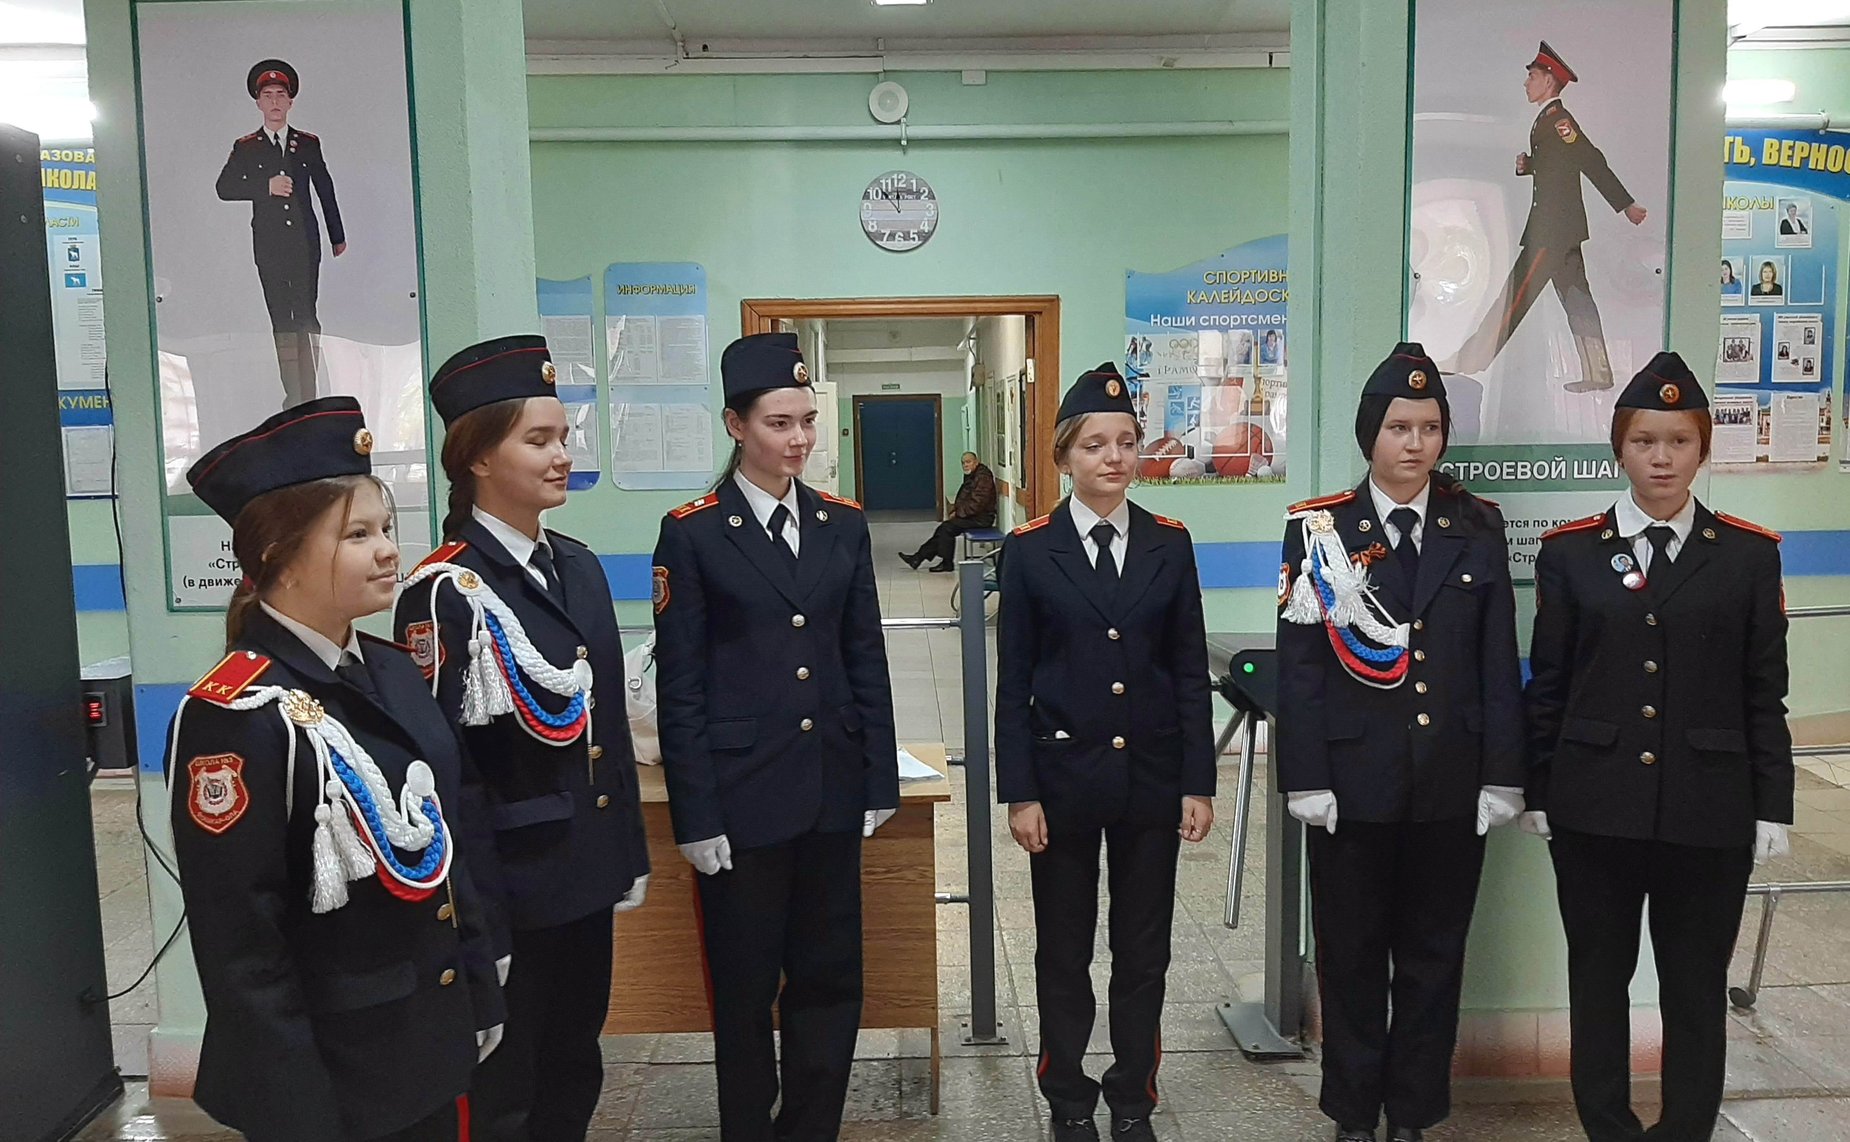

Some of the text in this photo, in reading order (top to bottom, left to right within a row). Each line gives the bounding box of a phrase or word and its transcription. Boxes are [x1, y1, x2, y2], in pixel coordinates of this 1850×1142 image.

[880, 178, 892, 192] 11
[892, 173, 906, 188] 12
[910, 178, 917, 192] 1
[867, 187, 881, 200] 10
[920, 187, 929, 200] 2
[863, 202, 872, 218] 9
[926, 203, 935, 217] 3
[868, 219, 878, 233] 8
[920, 218, 929, 233] 4
[881, 230, 891, 242] 7
[909, 229, 919, 243] 5
[617, 283, 697, 296] ИНФОРМАЦИЯ
[1187, 287, 1289, 305] КАЛЕЙДОСК
[1150, 314, 1196, 327] Наши
[1439, 457, 1568, 481] СТРОЕВОЙ
[1533, 520, 1548, 528] по
[183, 575, 195, 588] (в
